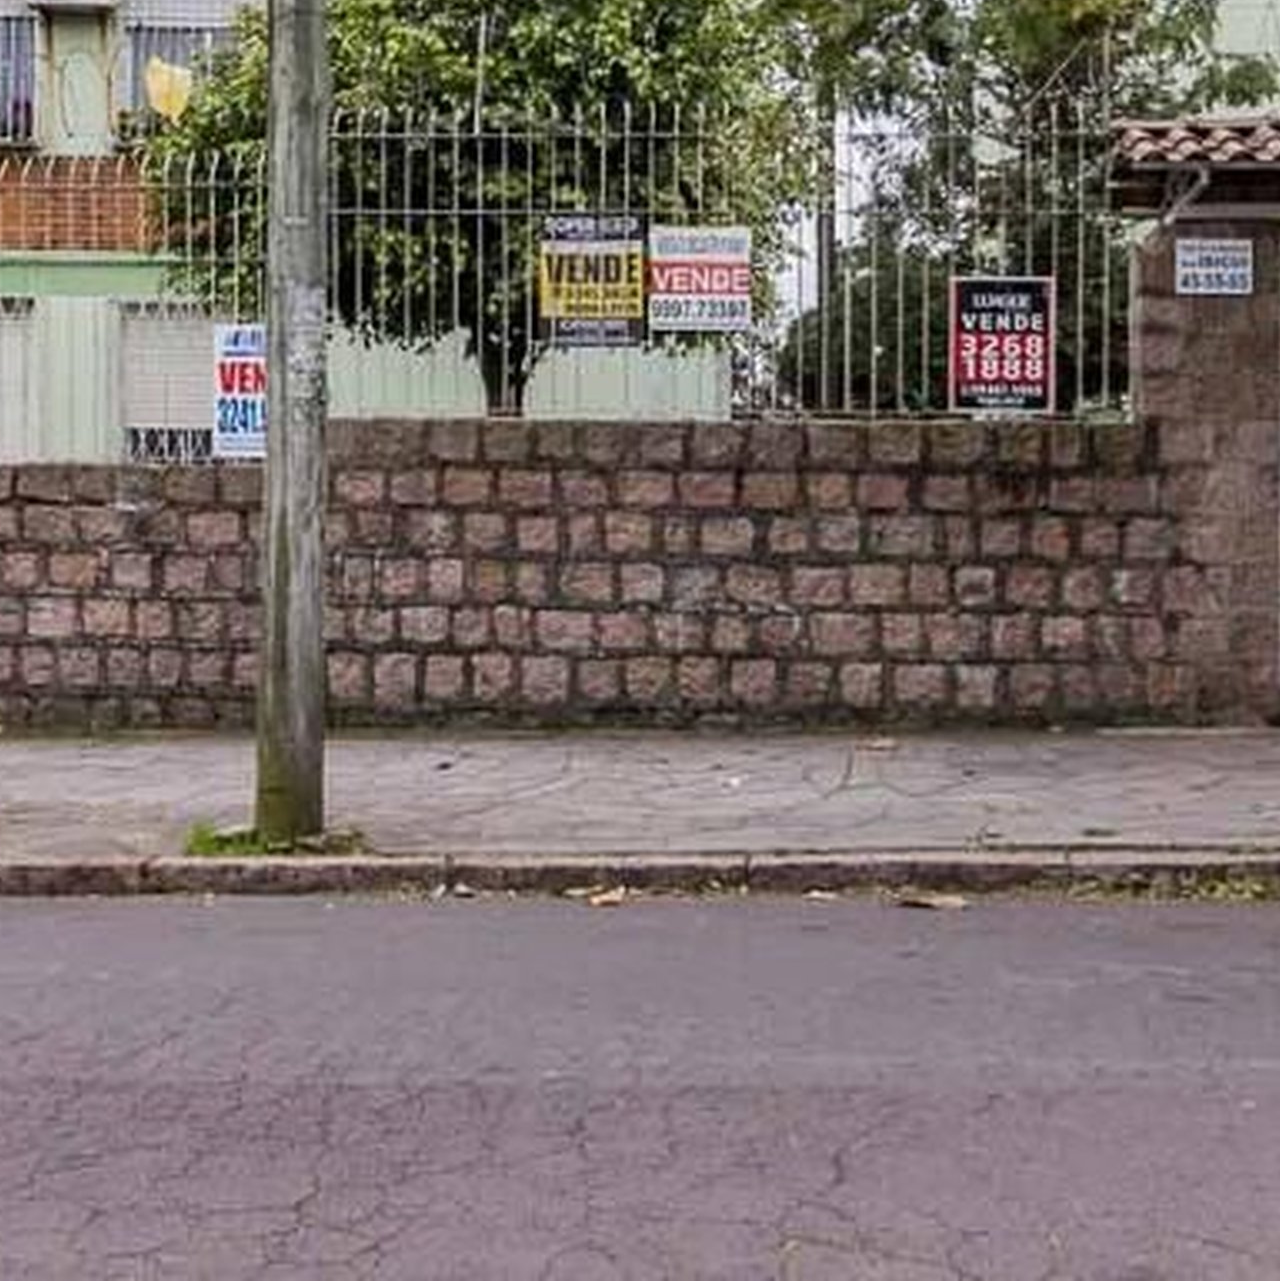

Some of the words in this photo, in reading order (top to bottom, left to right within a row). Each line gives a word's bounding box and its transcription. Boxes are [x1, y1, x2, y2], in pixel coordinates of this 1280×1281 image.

[545, 253, 638, 284] VENDE
[651, 266, 750, 292] VENDE
[961, 313, 1044, 331] VENDE
[961, 334, 1044, 357] 3268
[961, 358, 1044, 380] 1888
